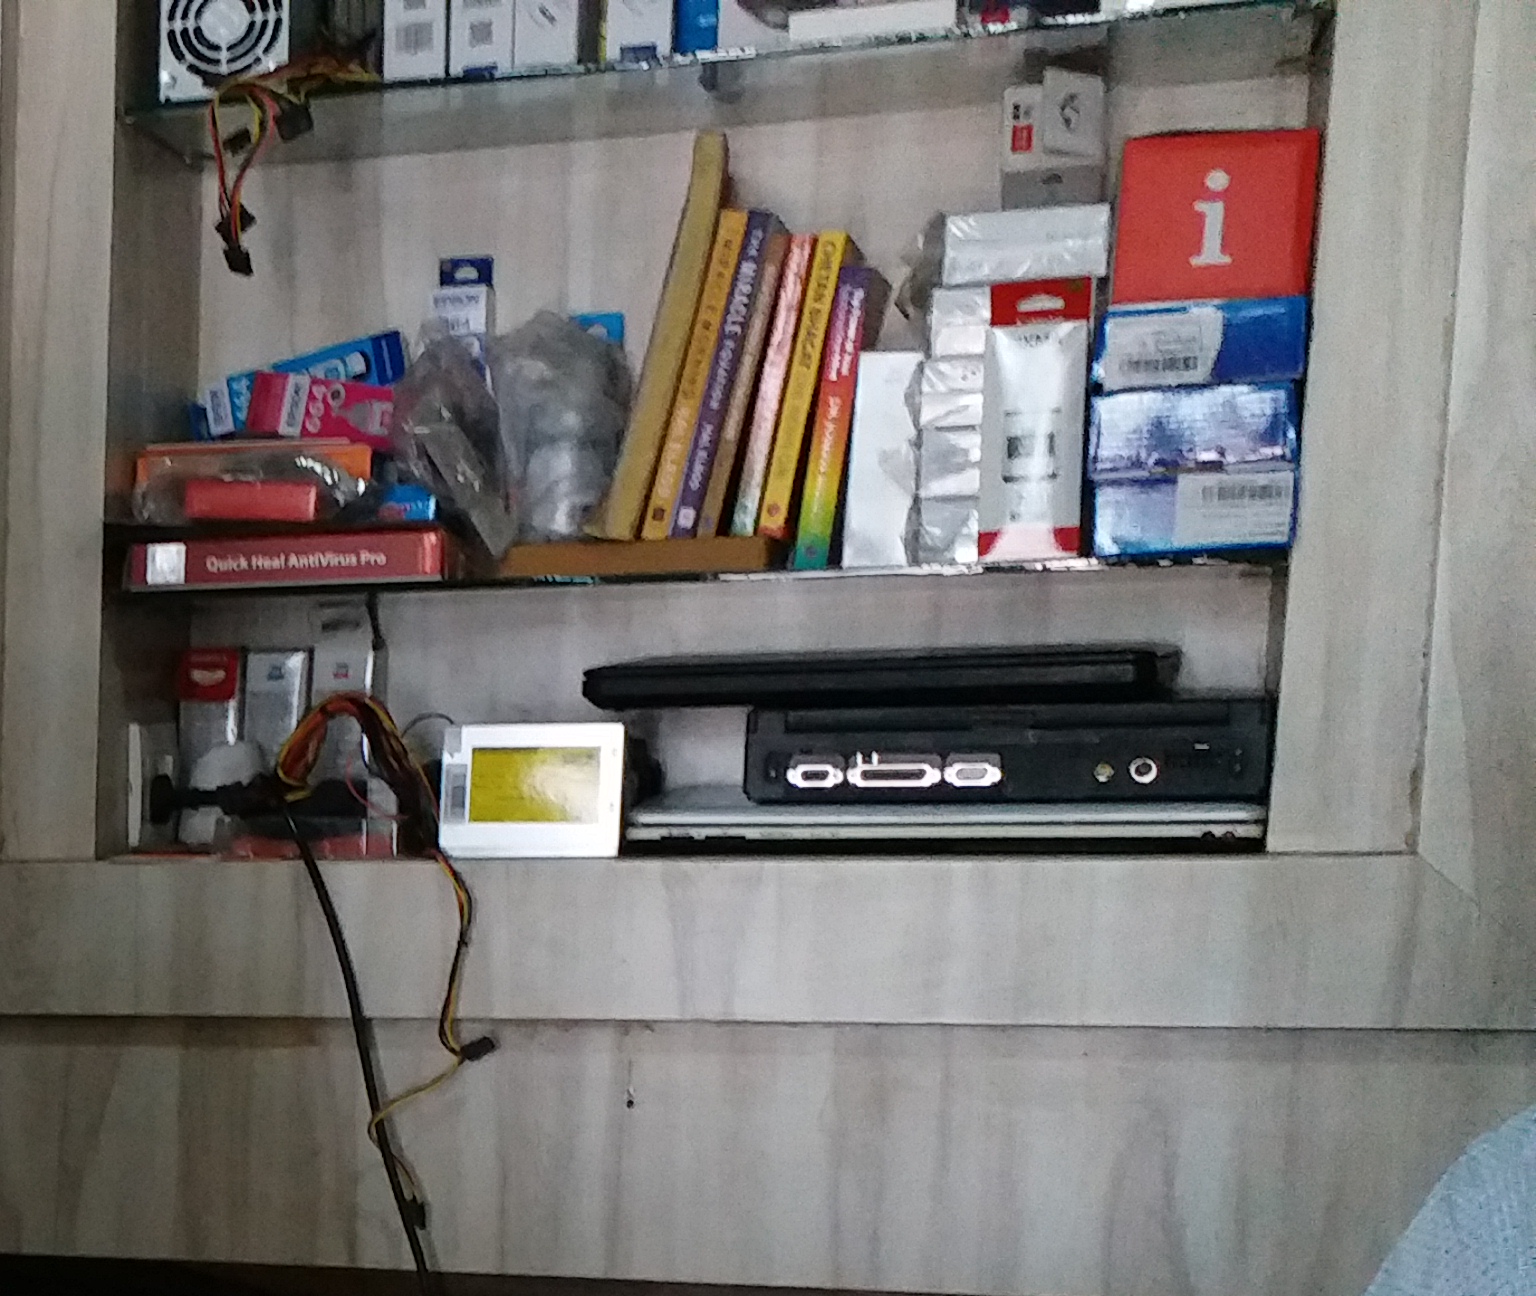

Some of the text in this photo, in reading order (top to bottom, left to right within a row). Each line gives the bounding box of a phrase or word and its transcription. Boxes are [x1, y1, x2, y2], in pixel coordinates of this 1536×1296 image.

[723, 259, 758, 338] MIRACLE
[206, 549, 387, 573] Quick Heal AntiVirus Pro
